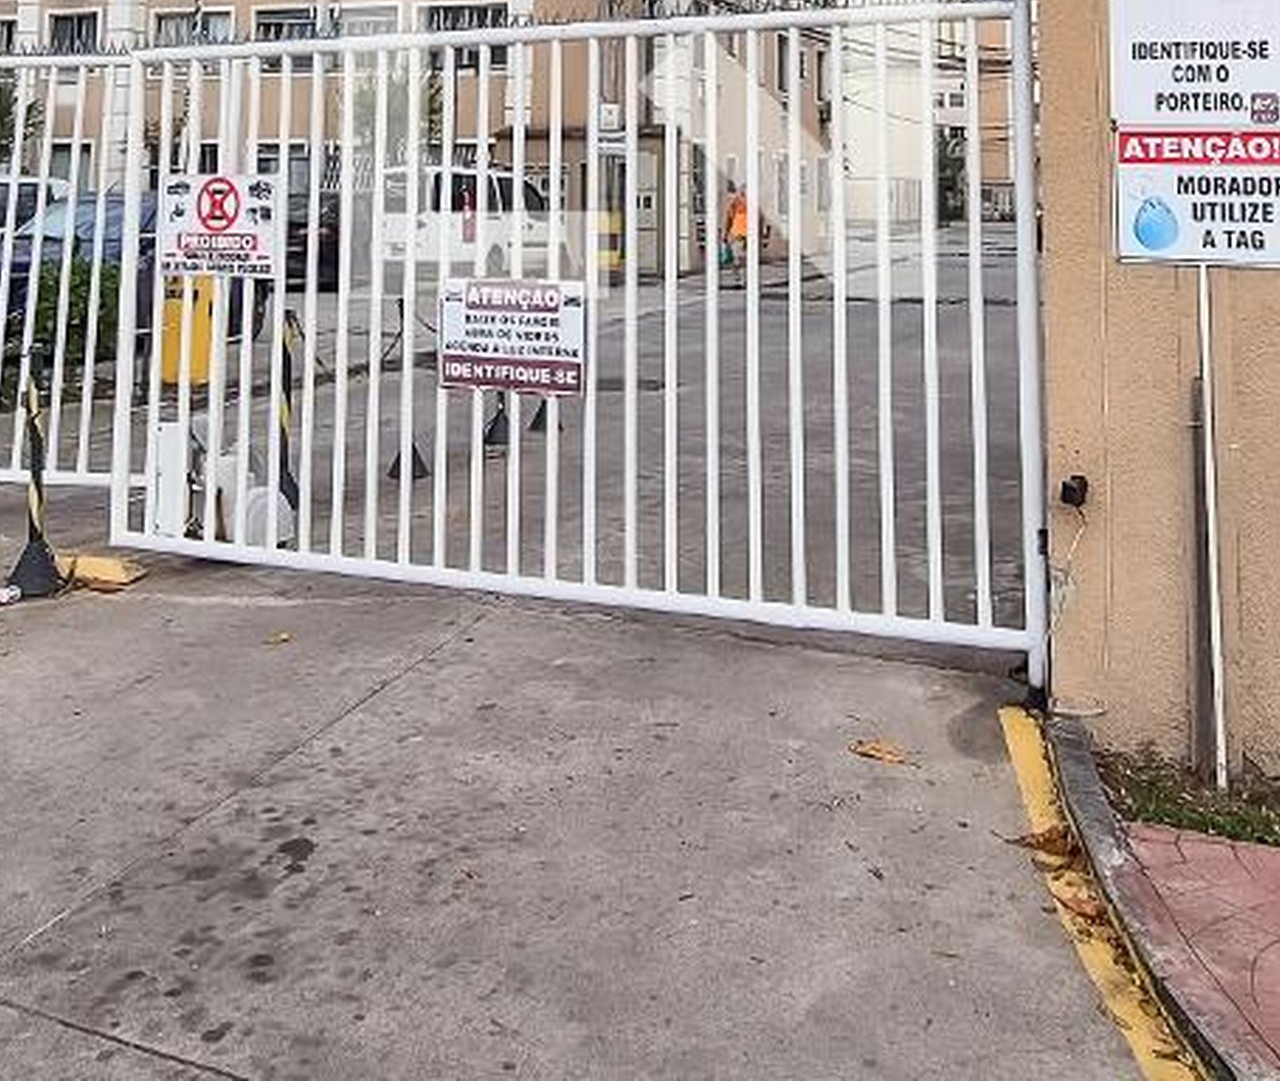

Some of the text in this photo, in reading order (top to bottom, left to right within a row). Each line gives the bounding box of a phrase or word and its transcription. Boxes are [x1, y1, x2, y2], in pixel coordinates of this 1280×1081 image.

[1131, 40, 1270, 61] IDENTIFIQUE-SE
[1171, 64, 1230, 83] COM O
[1155, 92, 1249, 112] PORTEIRO.
[1123, 131, 1280, 165] ATENÇÃO!
[1192, 203, 1274, 223] UTILIZE
[1202, 229, 1265, 250] A TAG
[444, 362, 578, 384] IDENTIFIQUE-SE
